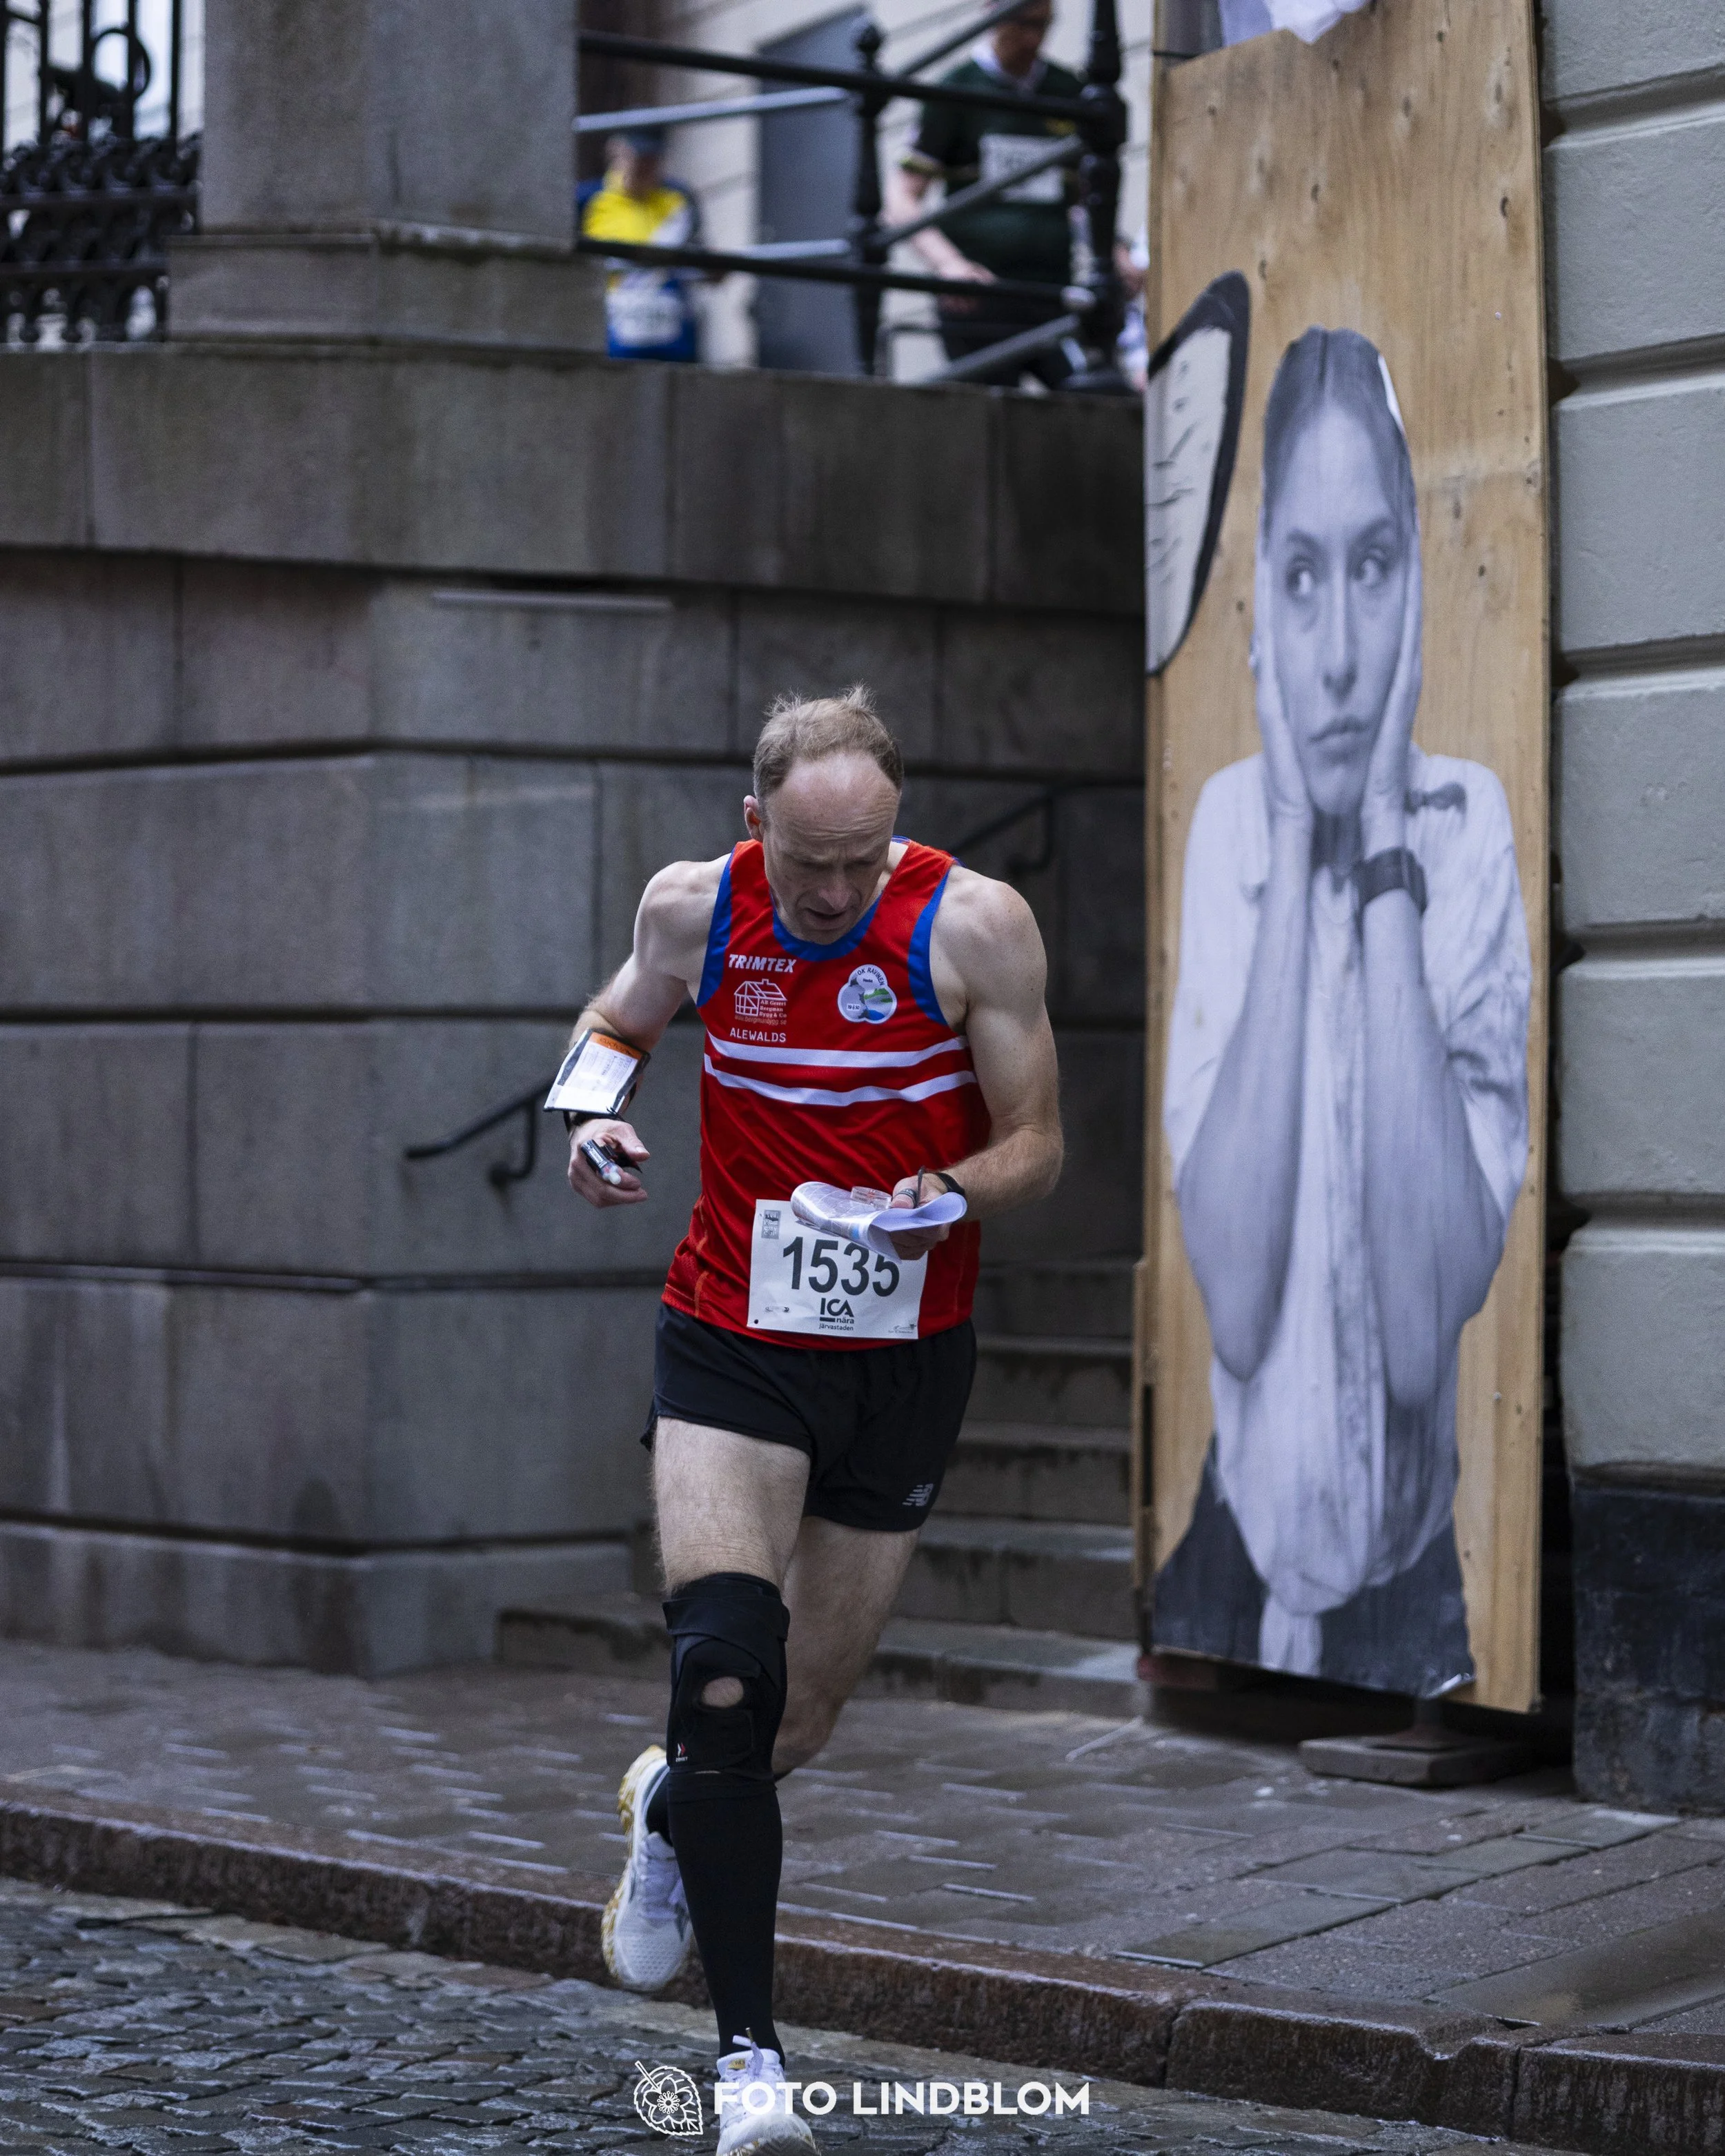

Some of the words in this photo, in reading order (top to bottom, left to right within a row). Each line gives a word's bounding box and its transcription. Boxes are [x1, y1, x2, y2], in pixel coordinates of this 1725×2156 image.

[729, 954, 796, 973] TRIMTEX
[857, 967, 865, 976] OK
[867, 967, 885, 986] RAVINEN
[730, 1027, 787, 1042] ALEWALDS
[782, 1236, 900, 1297] 1535
[820, 1298, 854, 1317] ICA
